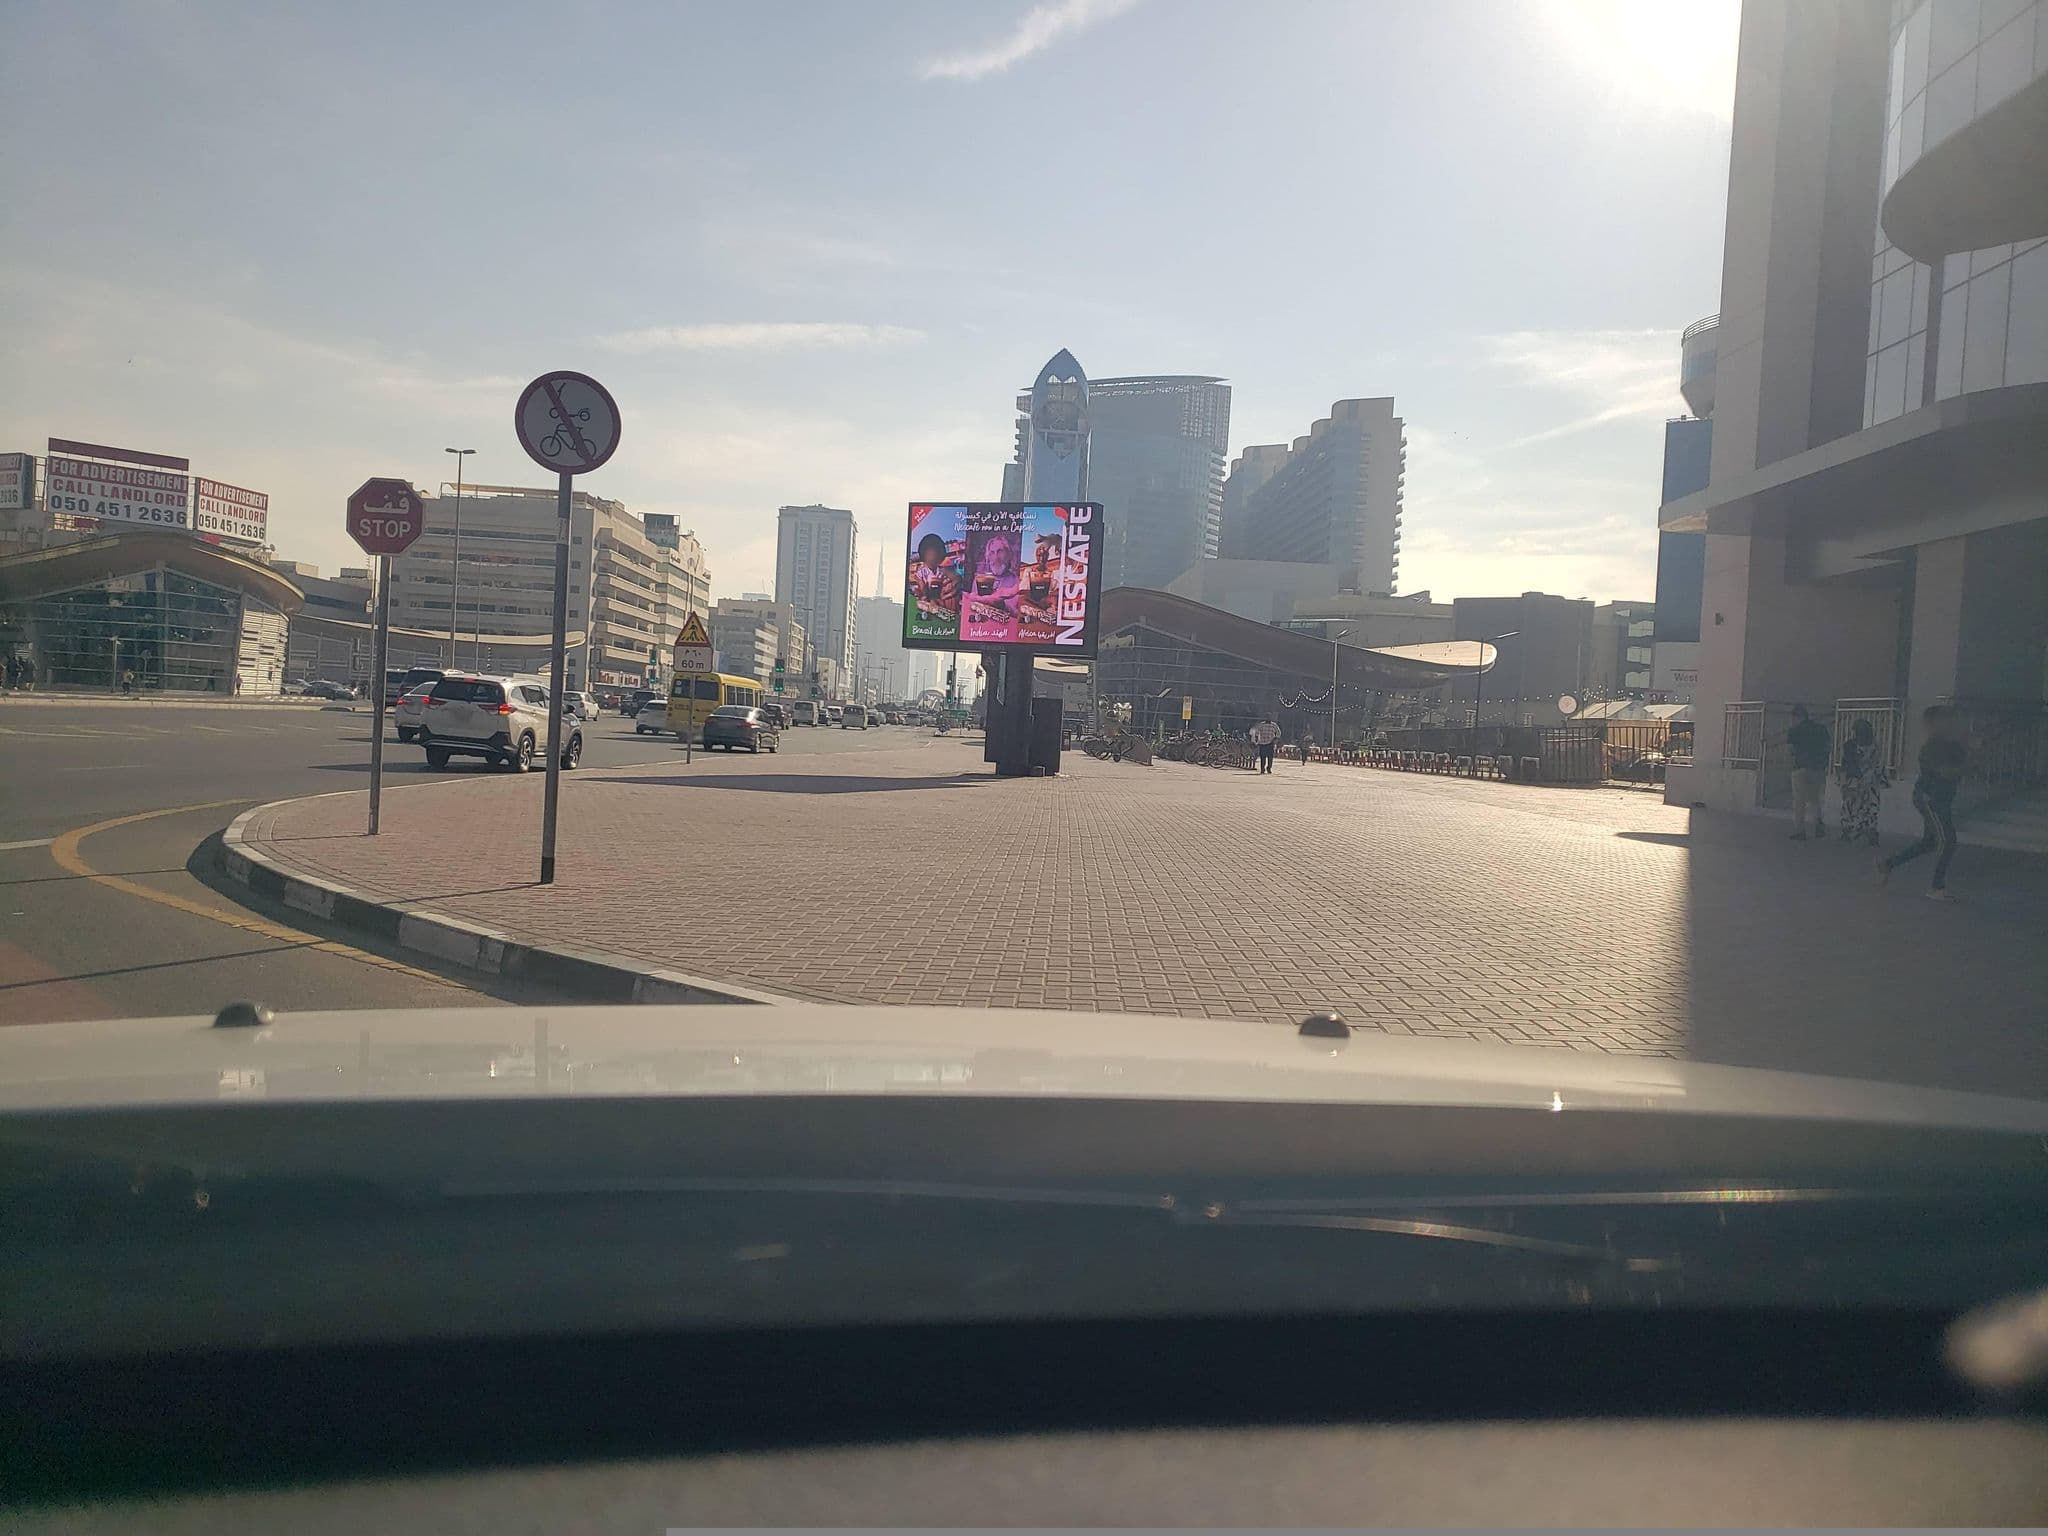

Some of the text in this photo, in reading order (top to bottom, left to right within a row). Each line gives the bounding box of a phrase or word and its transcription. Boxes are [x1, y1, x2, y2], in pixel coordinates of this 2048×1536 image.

[52, 459, 187, 491] FOR ADVERTISEMENT
[53, 478, 187, 507] CALL LANDLORD
[200, 480, 267, 508] FOR ADVERTISEMENT
[363, 490, 410, 514] قف
[51, 495, 187, 524] 050 451 2636
[200, 498, 265, 523] CALL LANDLORD
[199, 514, 265, 539] 050 451 2636
[360, 519, 411, 537] STOP
[970, 626, 990, 637] India
[681, 659, 694, 668] 60
